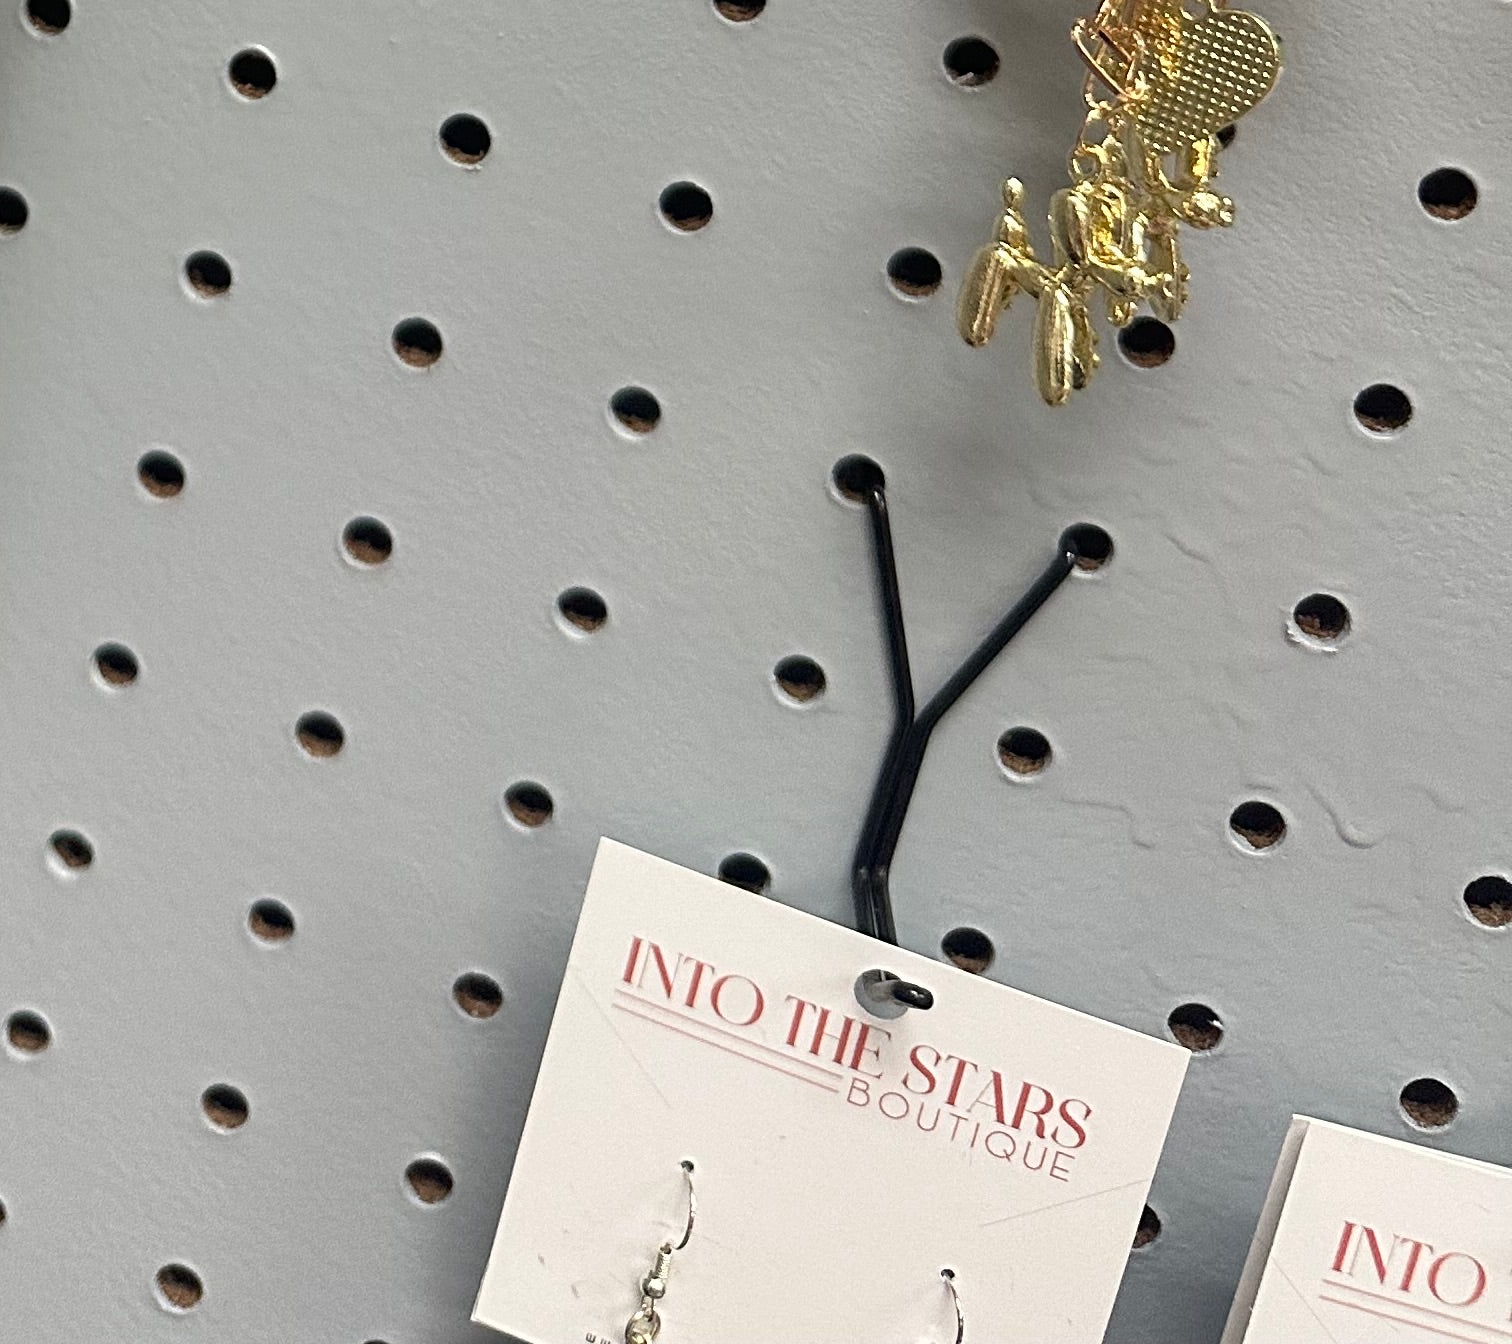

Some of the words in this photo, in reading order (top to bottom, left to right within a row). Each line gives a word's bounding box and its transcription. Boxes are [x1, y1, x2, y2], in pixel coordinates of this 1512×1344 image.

[622, 935, 765, 1027] INTO
[785, 994, 893, 1080] THE
[901, 1044, 1093, 1150] STARS
[846, 1077, 1078, 1183] BOUTIQUE
[1331, 1220, 1487, 1307] INTO
